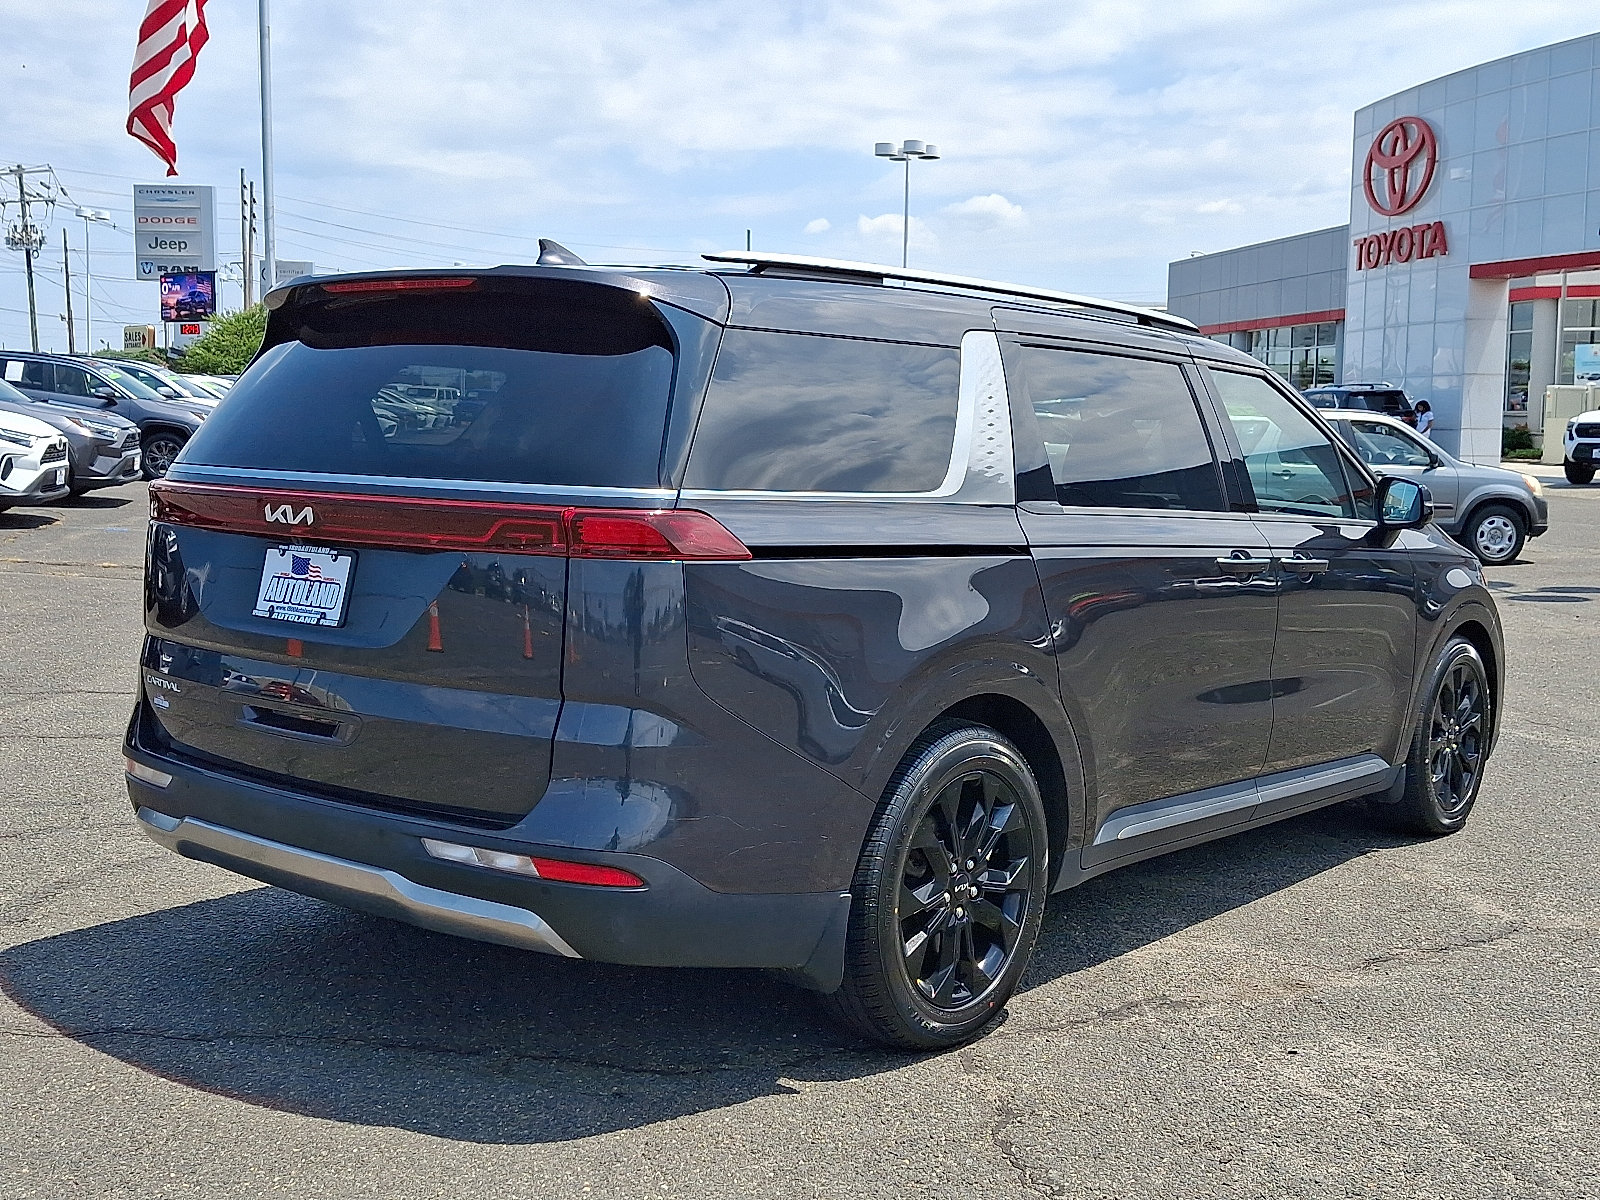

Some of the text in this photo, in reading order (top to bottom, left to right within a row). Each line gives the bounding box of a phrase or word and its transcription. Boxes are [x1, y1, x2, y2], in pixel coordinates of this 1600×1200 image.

[138, 216, 197, 224] DODGE
[148, 236, 188, 253] Jeep
[1353, 220, 1449, 272] TOYOTA
[157, 265, 199, 273] RAM
[124, 331, 141, 342] SALES
[264, 502, 314, 526] KIA
[264, 577, 340, 608] AUTOLAND
[271, 612, 318, 625] AUTOLAND
